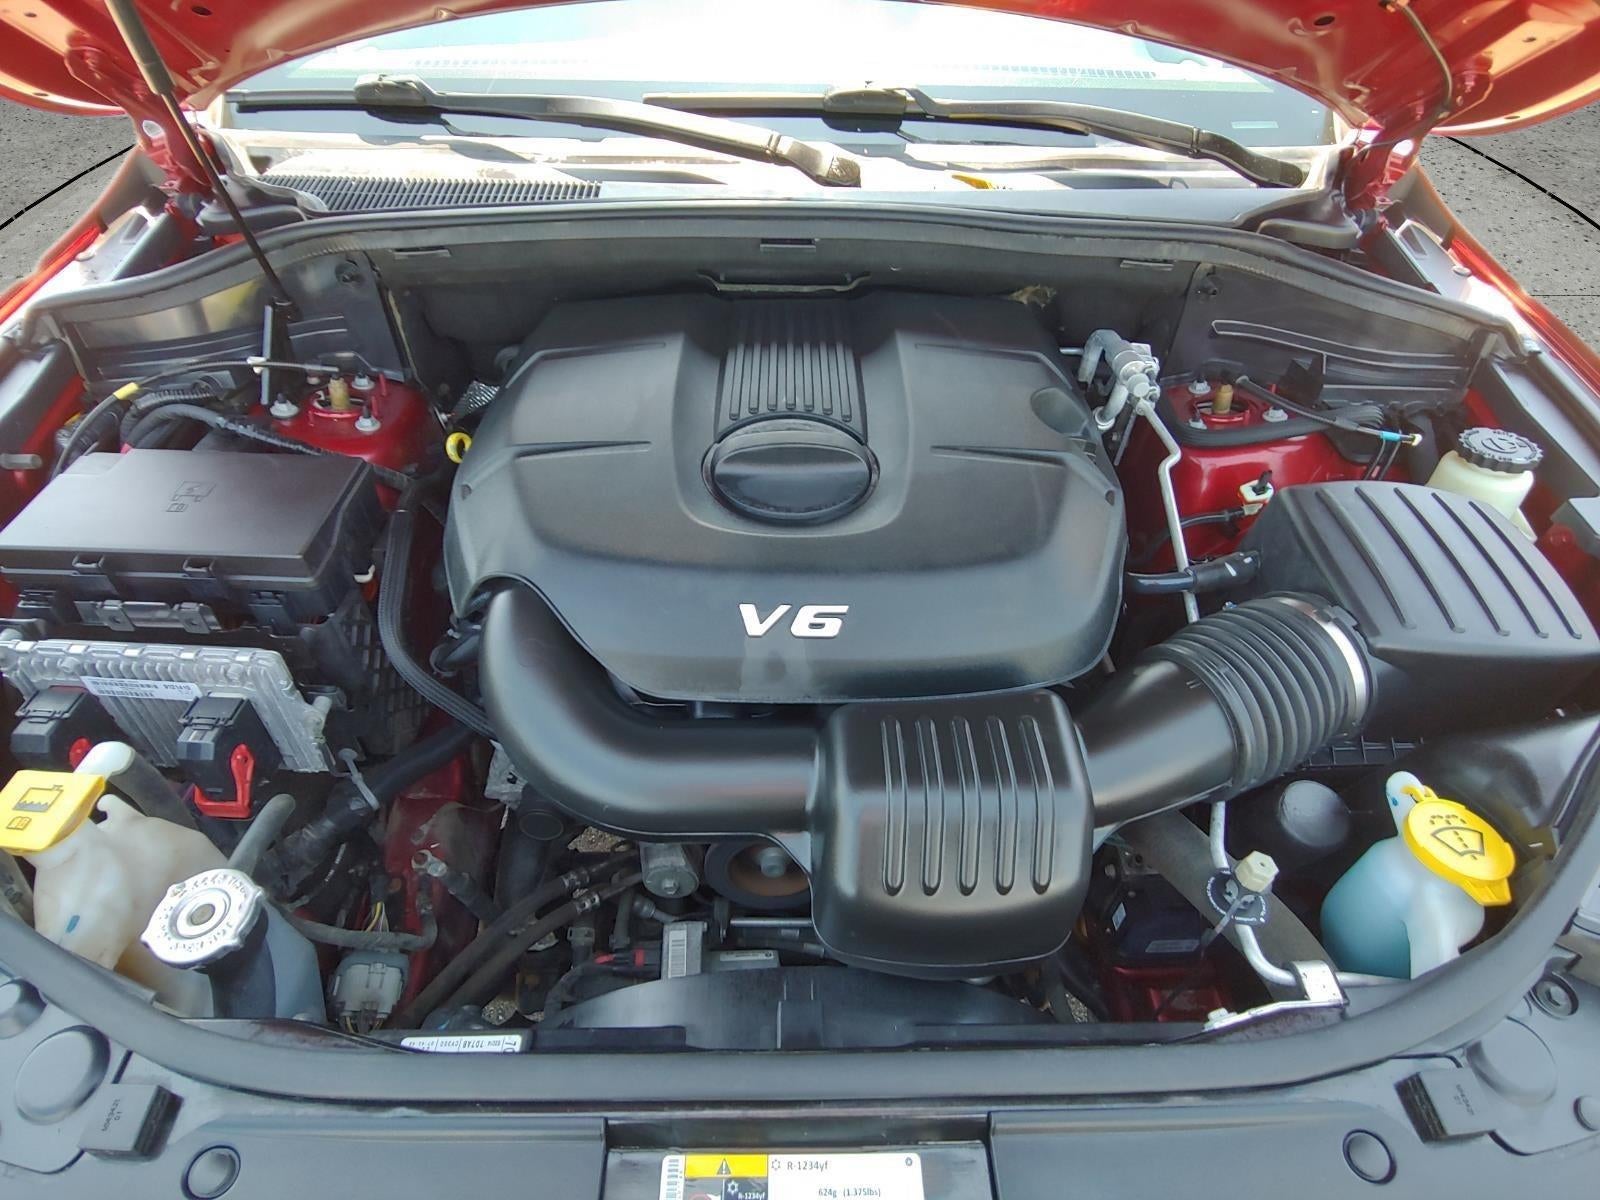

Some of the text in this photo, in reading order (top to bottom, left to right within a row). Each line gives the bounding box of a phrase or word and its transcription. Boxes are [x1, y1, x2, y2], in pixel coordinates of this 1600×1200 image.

[739, 604, 849, 638] V6
[787, 1160, 828, 1172] R-1234yf
[818, 1188, 838, 1198] 624g
